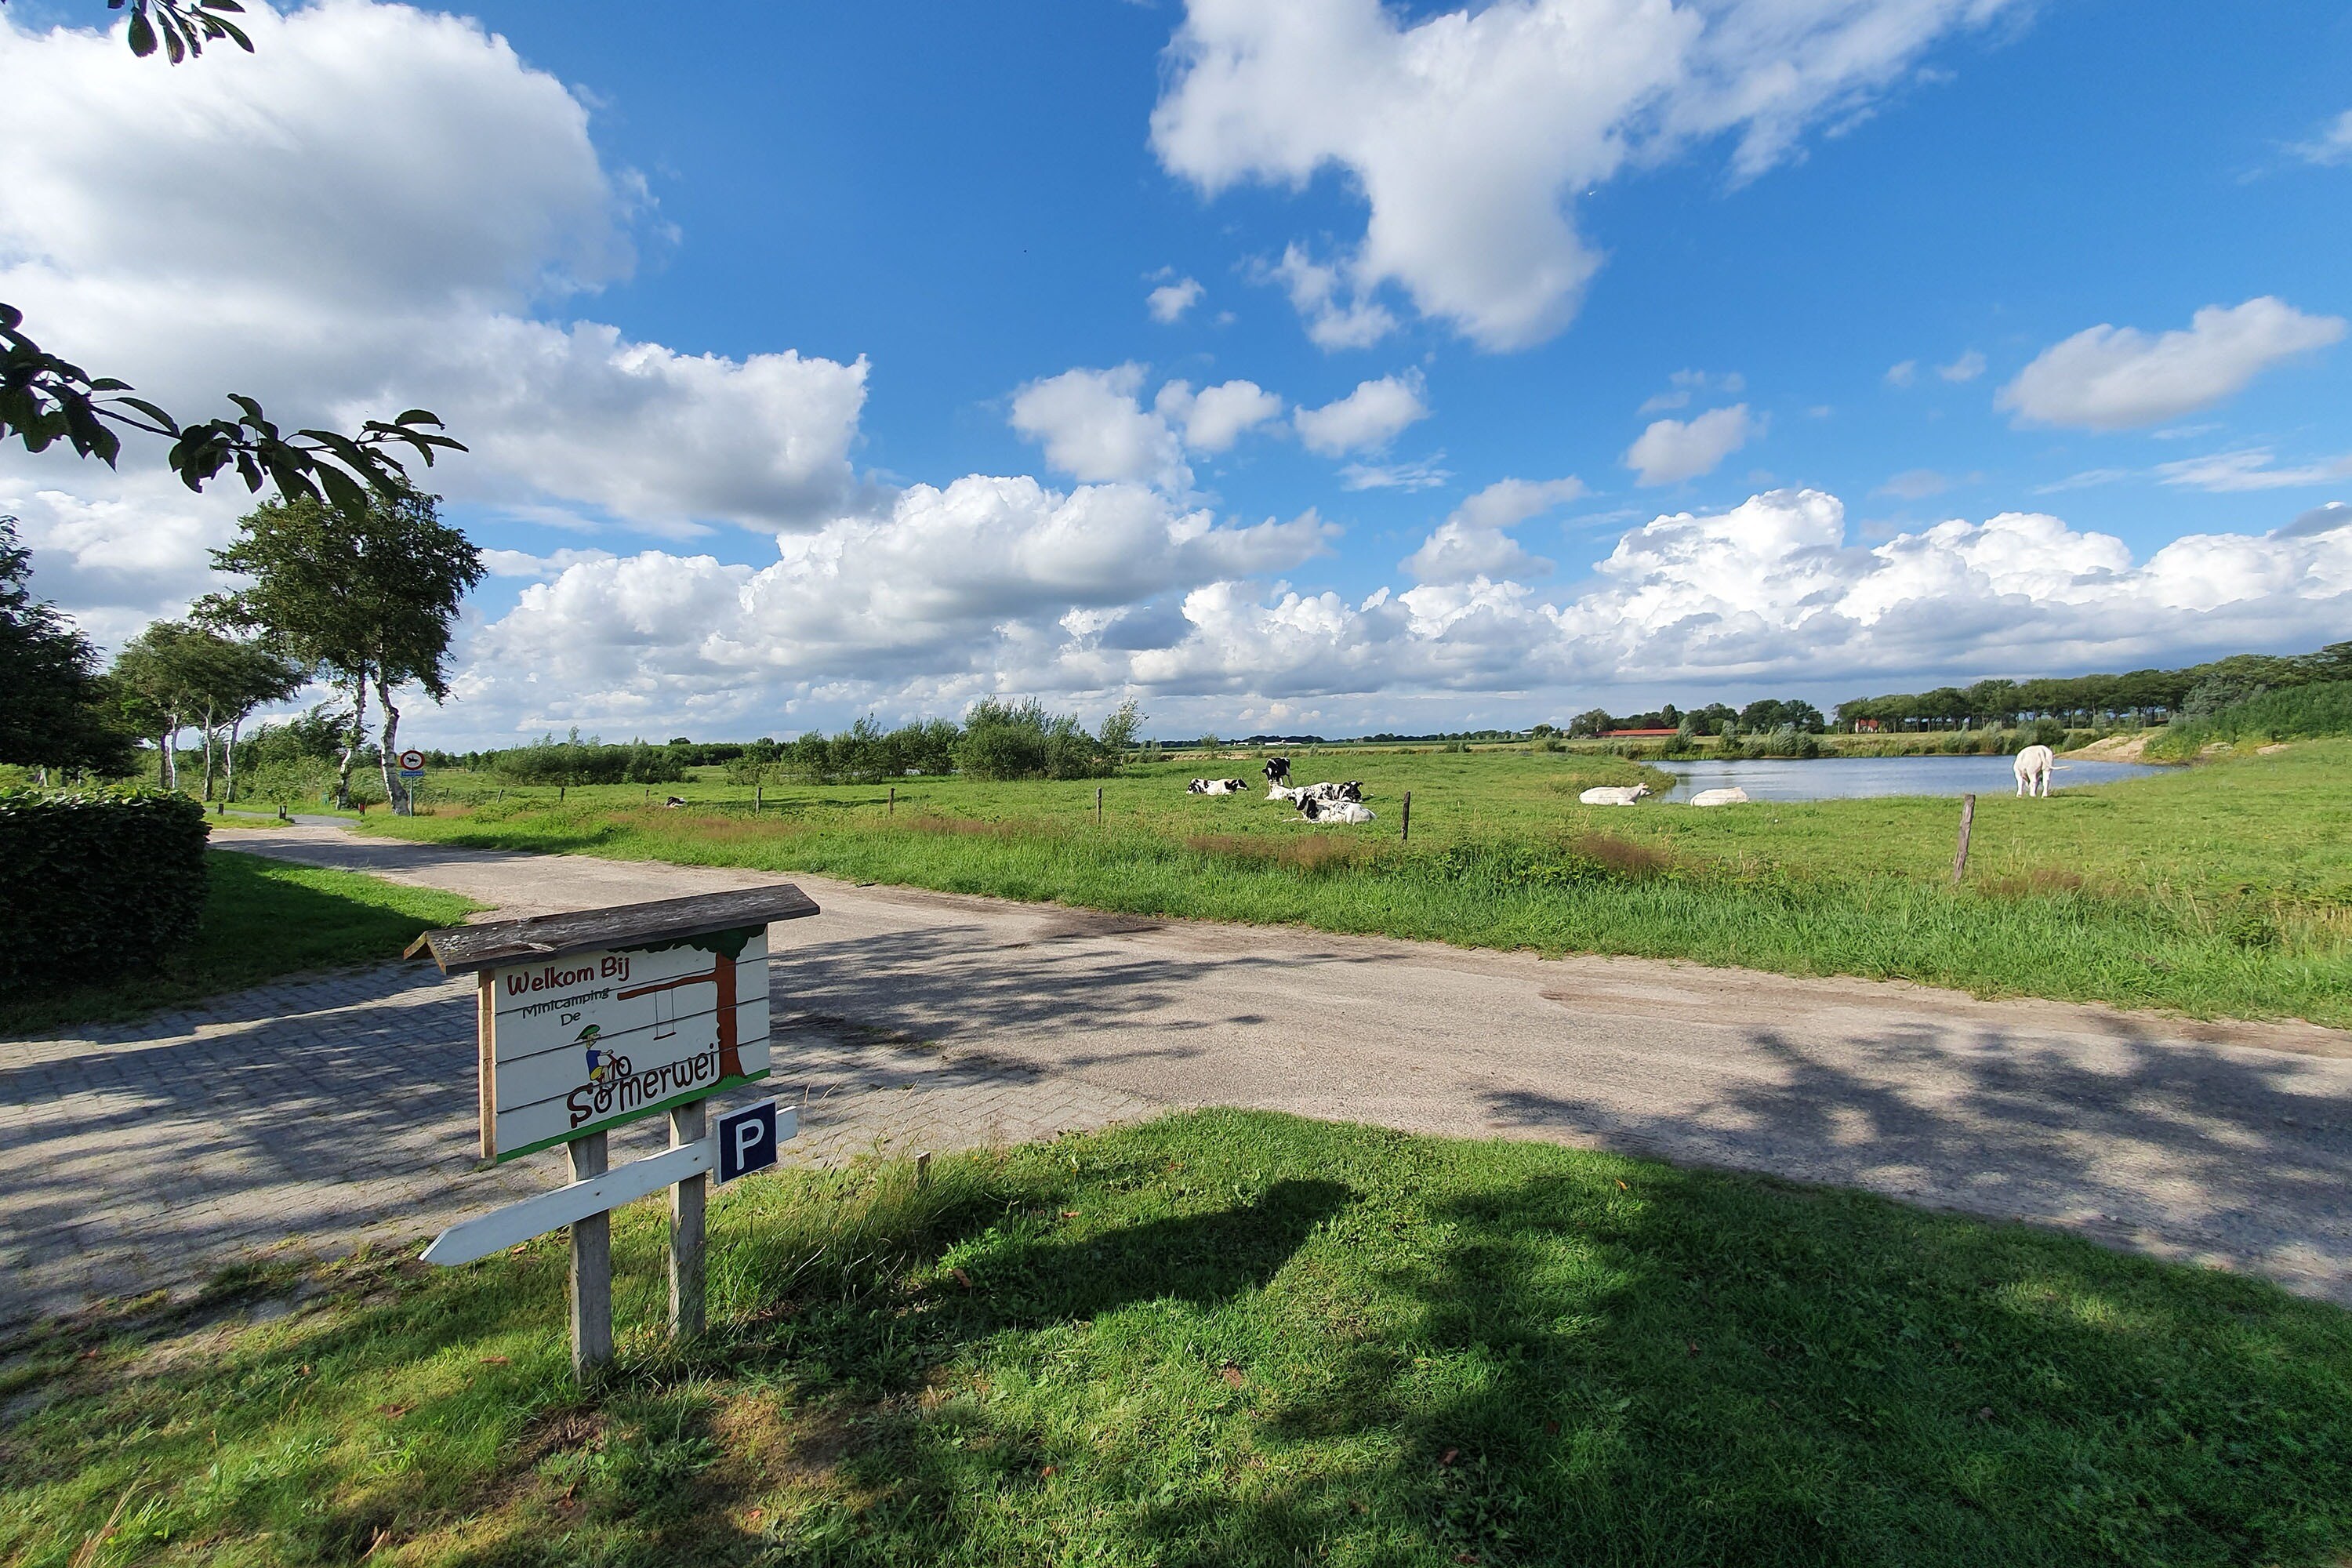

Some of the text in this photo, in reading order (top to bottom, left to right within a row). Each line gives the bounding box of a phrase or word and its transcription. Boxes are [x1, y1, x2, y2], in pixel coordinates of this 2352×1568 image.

[507, 956, 630, 996] Welkom Bij
[522, 987, 610, 1019] Minicamping
[561, 1011, 581, 1026] De
[735, 1118, 764, 1171] P
